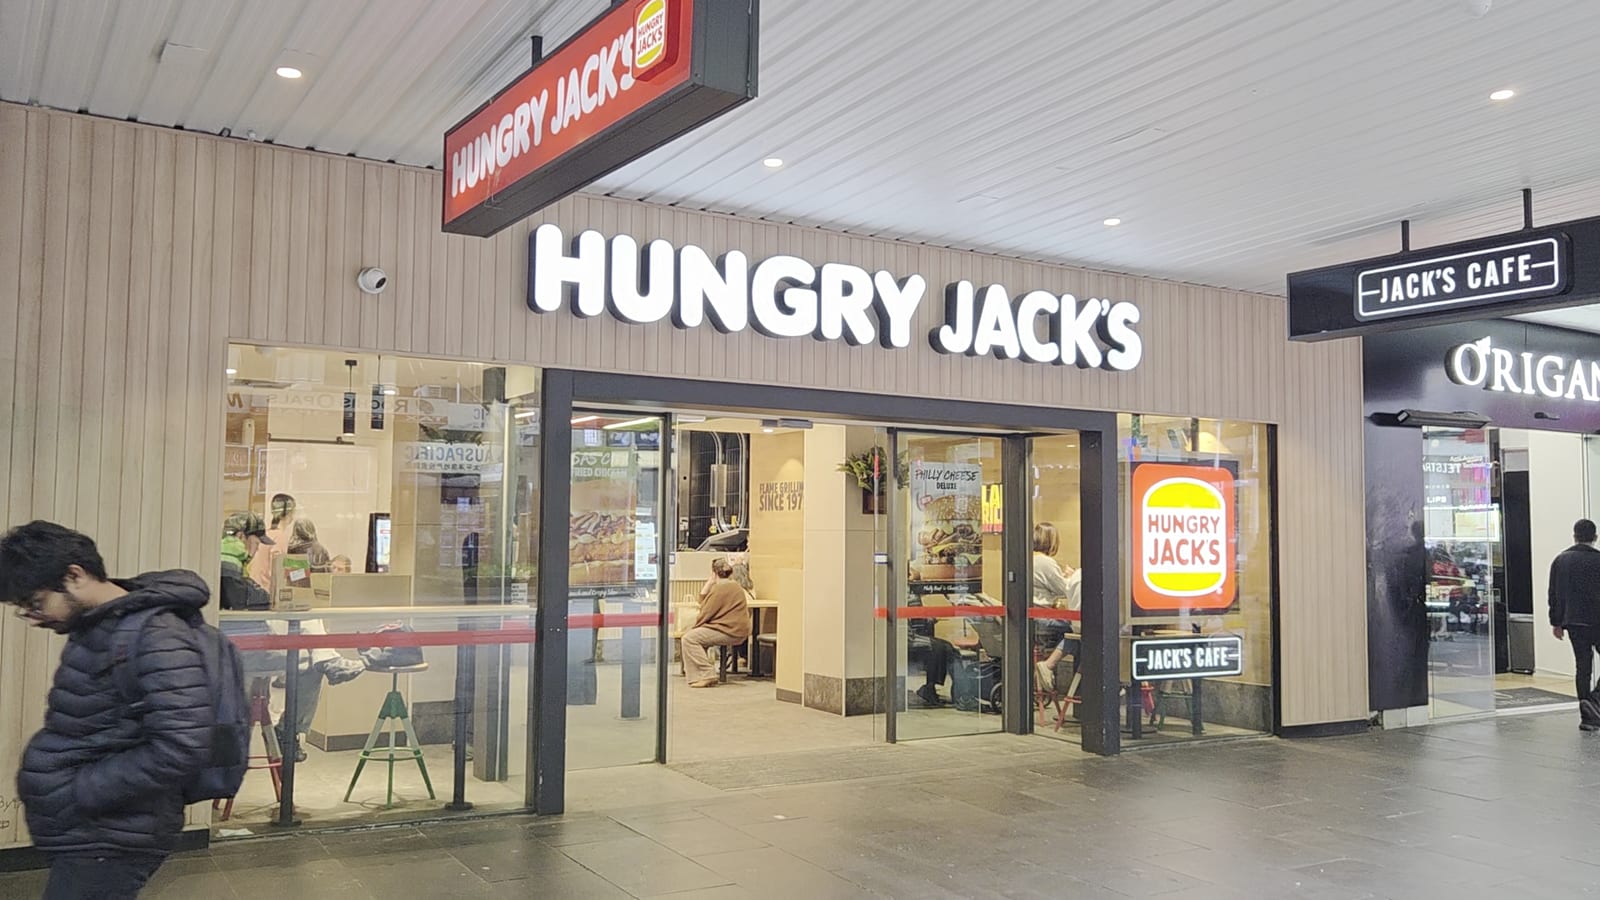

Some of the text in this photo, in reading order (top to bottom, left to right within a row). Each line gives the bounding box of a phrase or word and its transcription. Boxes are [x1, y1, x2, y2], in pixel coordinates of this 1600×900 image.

[638, 10, 664, 39] HUNGRY
[451, 27, 636, 198] HUNGRY JACK'S
[1379, 254, 1532, 303] JACK'S CAFE
[532, 223, 1143, 372] HUNGRY JACK'S
[915, 469, 979, 482] PHILLY CHEESE
[936, 482, 957, 490] DELUXE
[760, 482, 778, 494] FLAME
[759, 493, 804, 511] SINCE 197
[1148, 514, 1220, 533] HUNGRY
[1148, 537, 1220, 565] JACK'S
[1147, 647, 1229, 670] JACK'S CAFE
